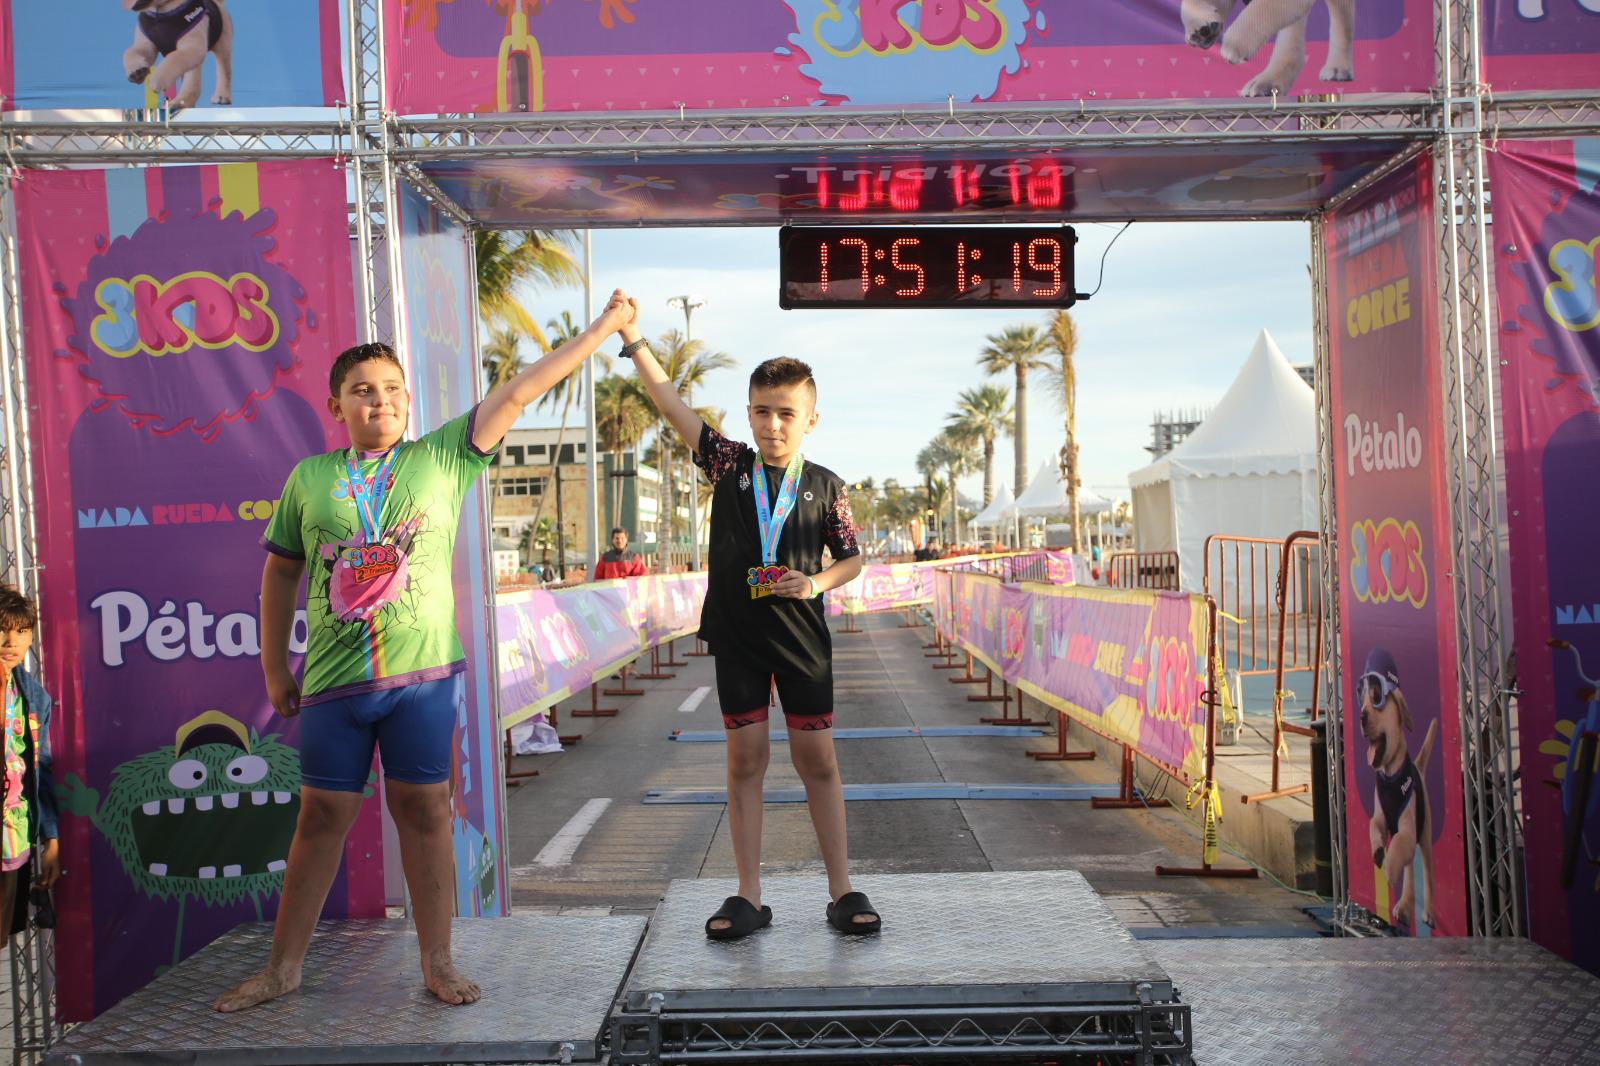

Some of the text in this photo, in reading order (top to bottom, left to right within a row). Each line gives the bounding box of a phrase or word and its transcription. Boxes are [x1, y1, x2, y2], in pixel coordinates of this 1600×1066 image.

[1347, 276, 1412, 338] CORRE
[1343, 412, 1423, 477] Pétalo
[78, 505, 149, 529] NADA
[151, 502, 236, 525] RUEDA
[91, 591, 308, 666] Pétao
